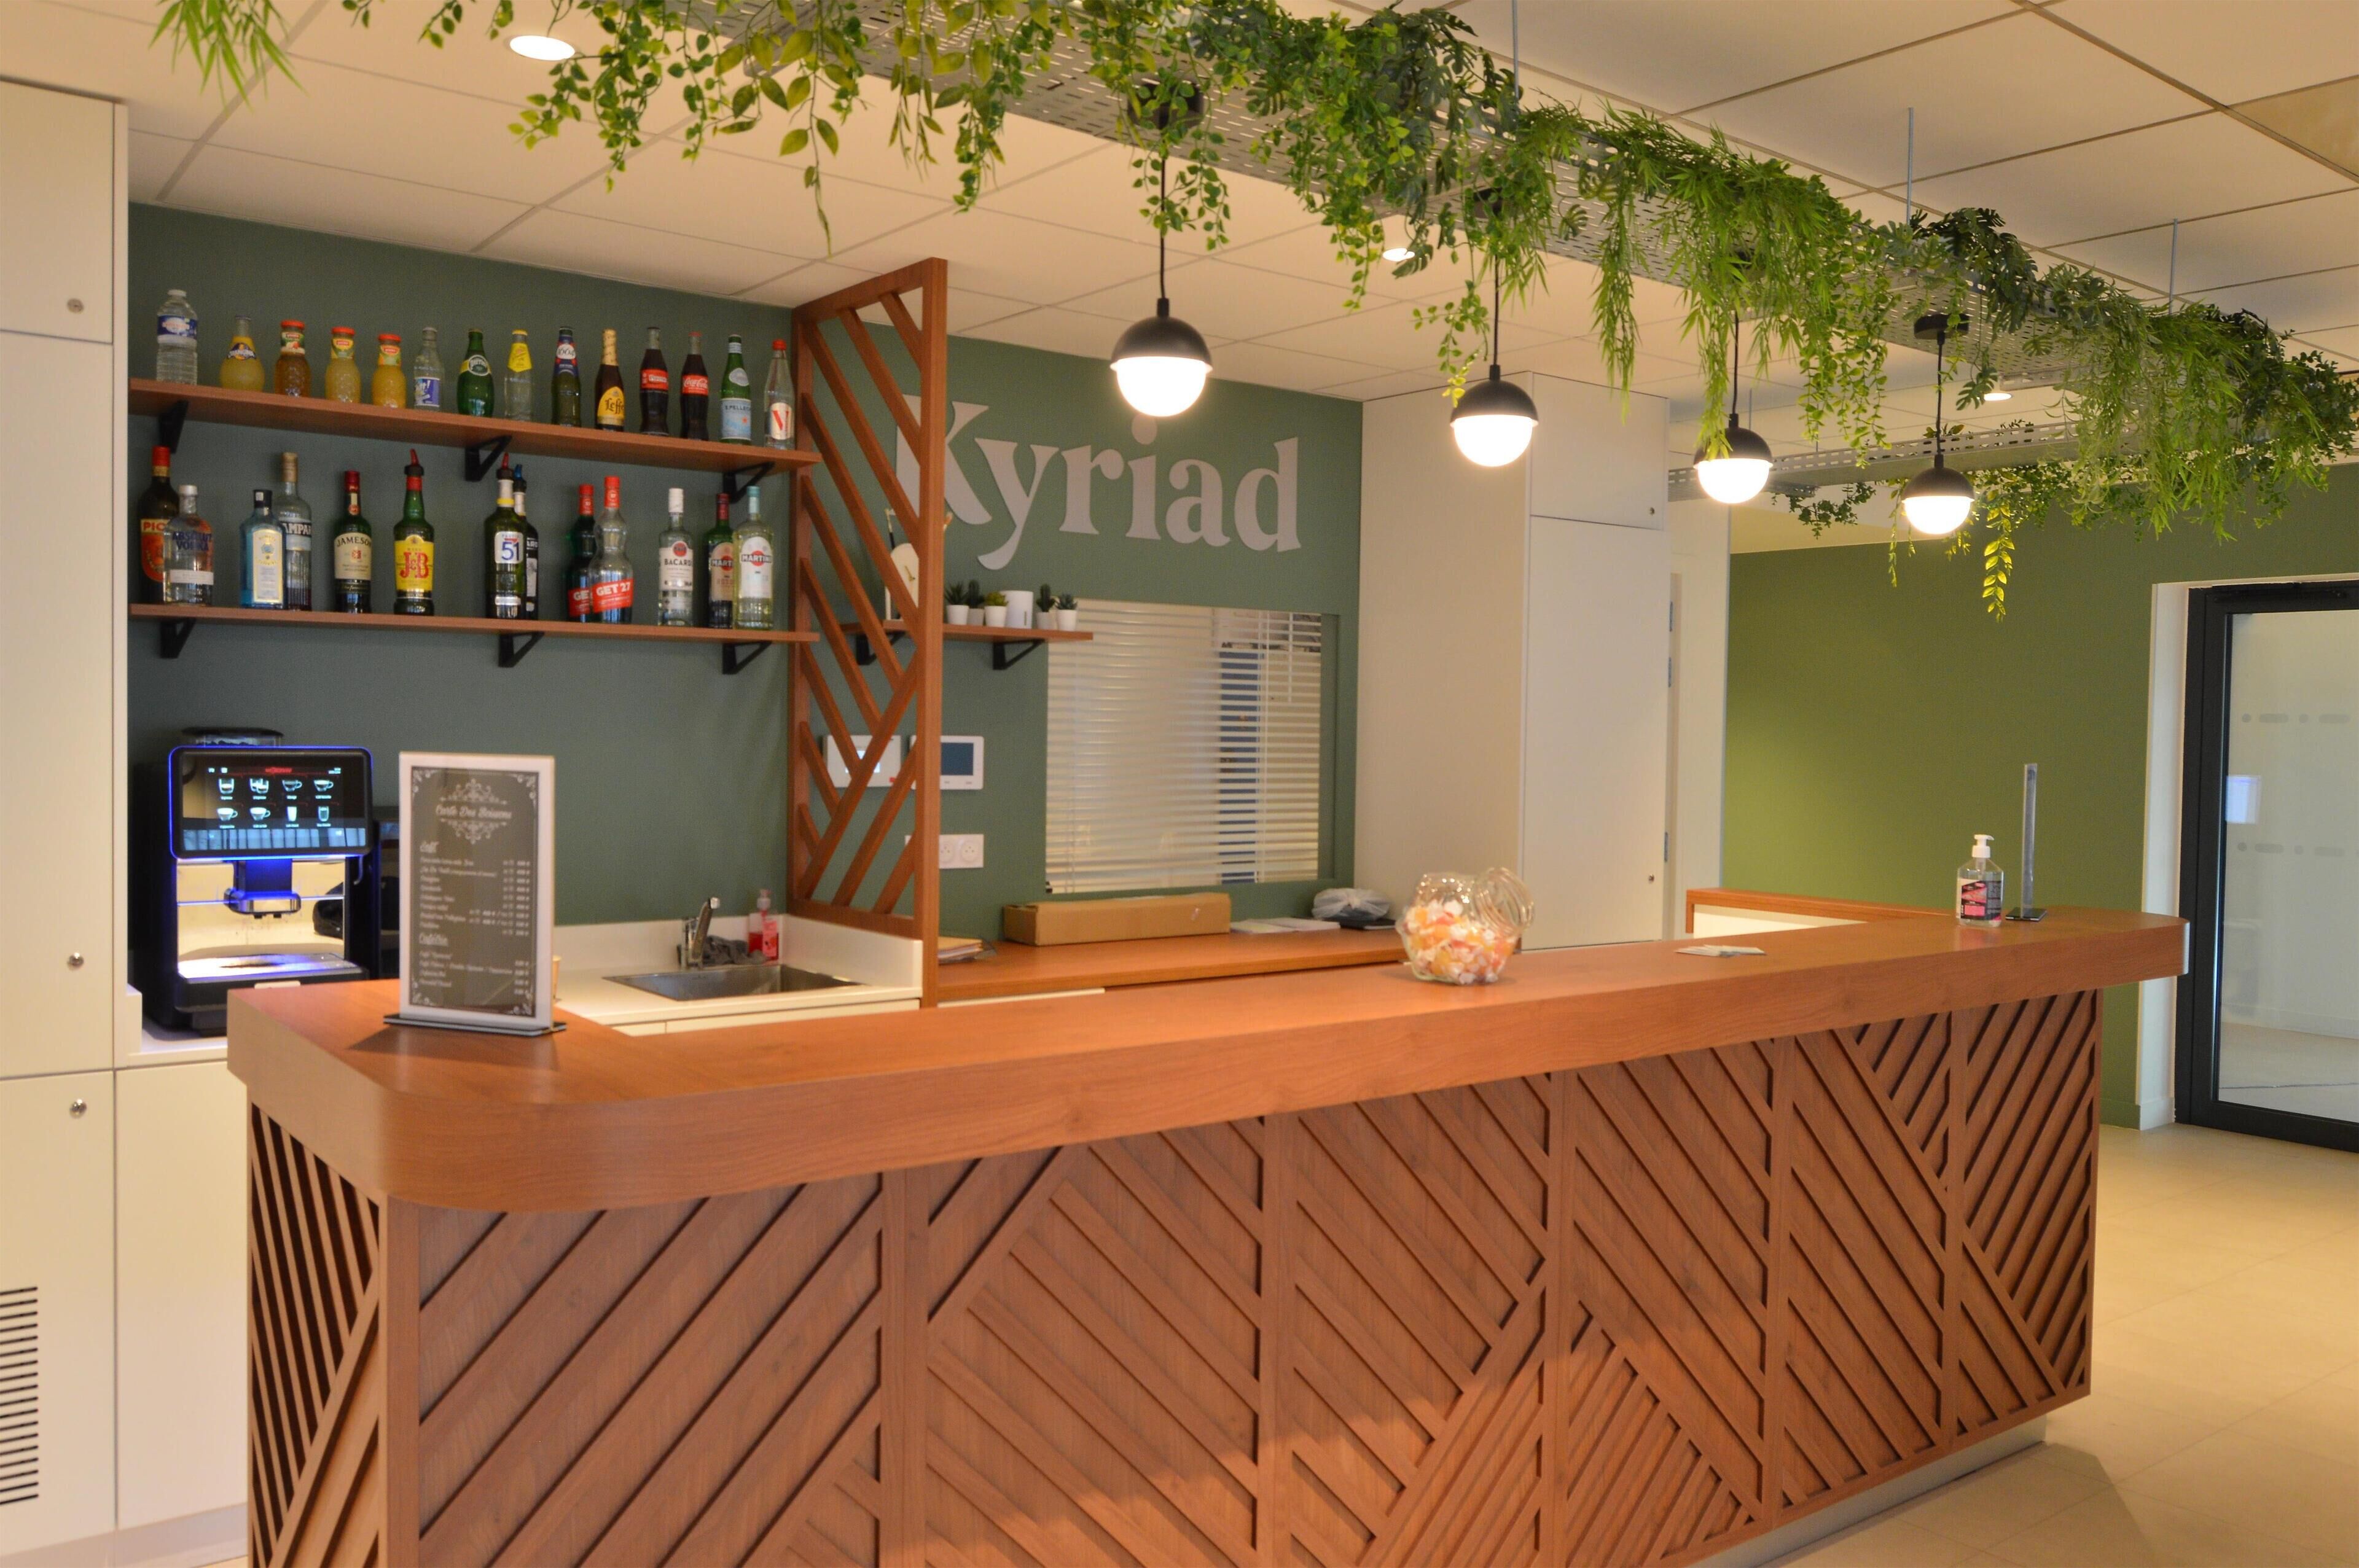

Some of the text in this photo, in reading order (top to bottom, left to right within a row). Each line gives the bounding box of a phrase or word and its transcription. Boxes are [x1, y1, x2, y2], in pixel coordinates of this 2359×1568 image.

[605, 399, 624, 415] Leffe
[896, 394, 1301, 570] Kyriad
[143, 521, 165, 531] PIC
[282, 523, 311, 535] AMPA
[501, 541, 520, 561] 51
[596, 581, 631, 596] GET 27
